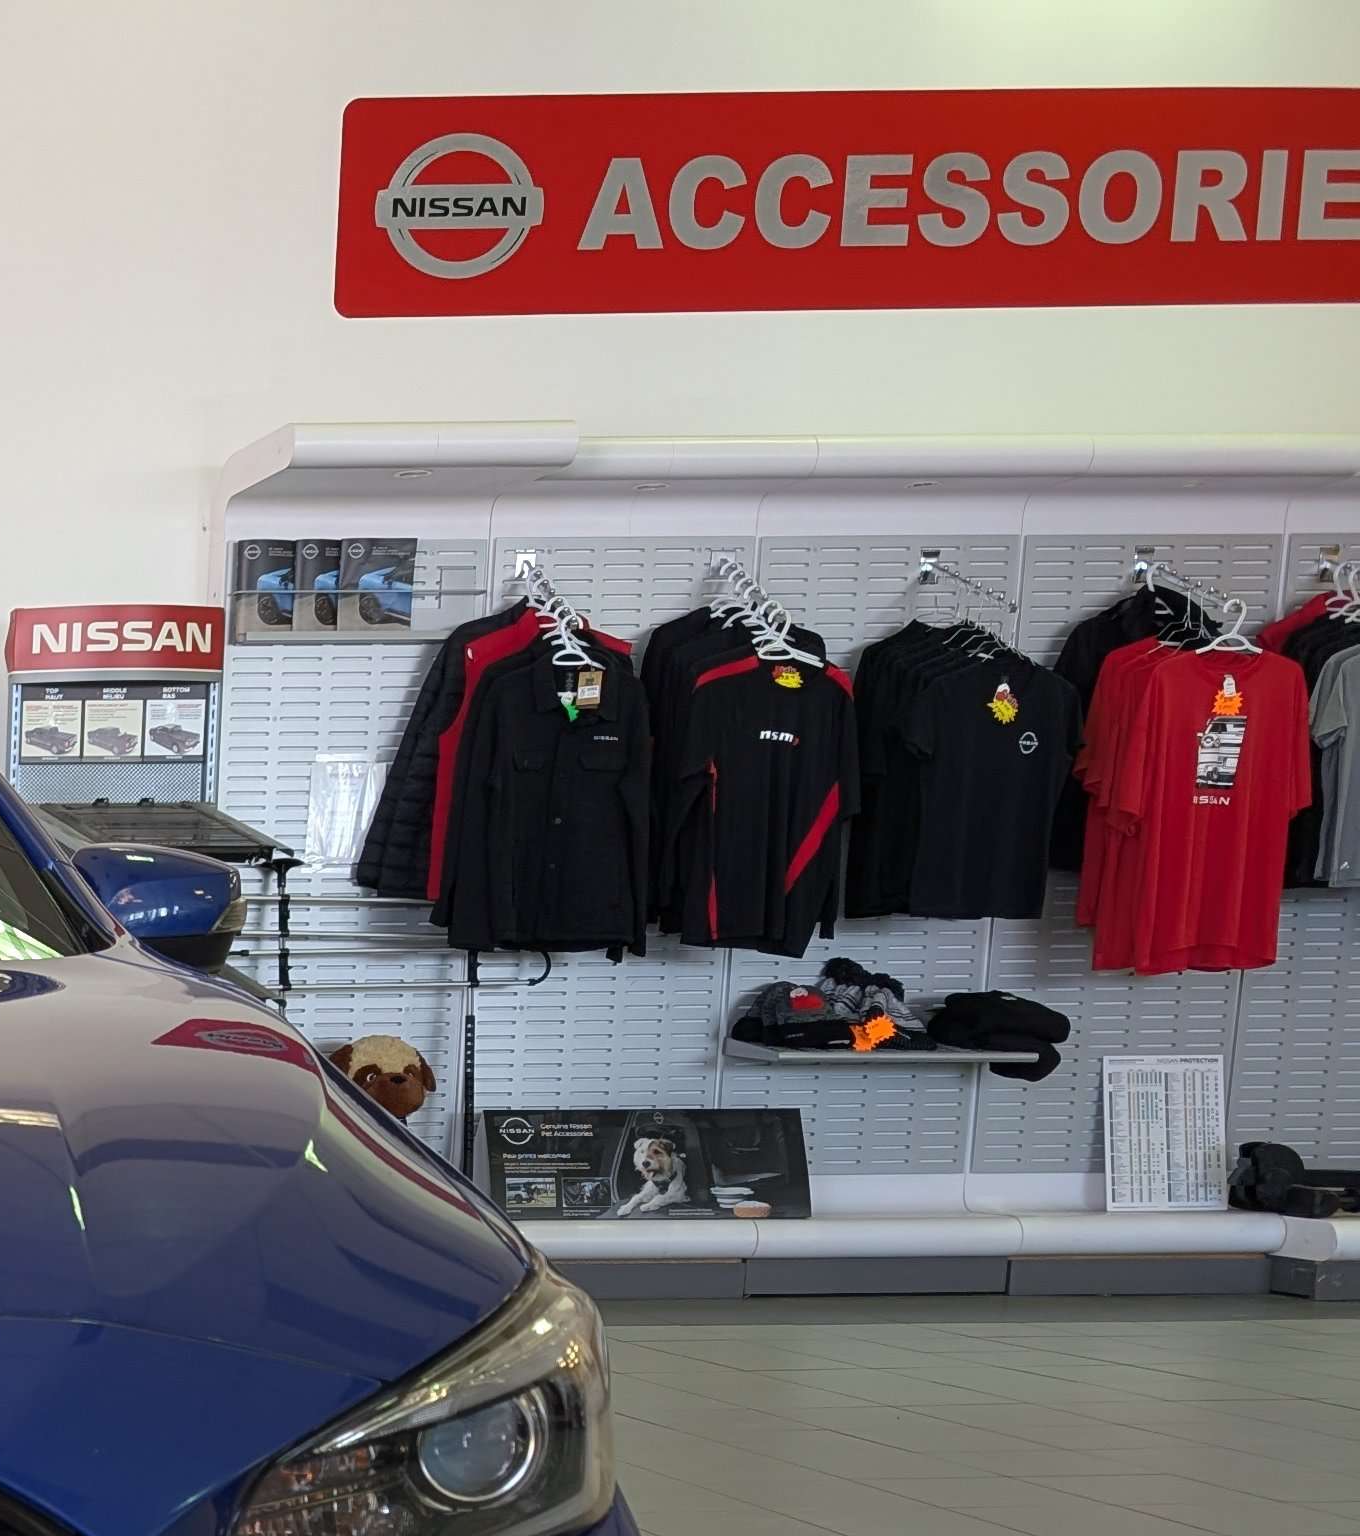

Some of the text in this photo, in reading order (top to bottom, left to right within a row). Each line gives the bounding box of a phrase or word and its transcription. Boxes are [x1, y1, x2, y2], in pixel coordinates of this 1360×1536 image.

[391, 195, 528, 219] NISSAN
[577, 149, 1360, 251] ACCESSORIE
[32, 621, 212, 654] NISSAN
